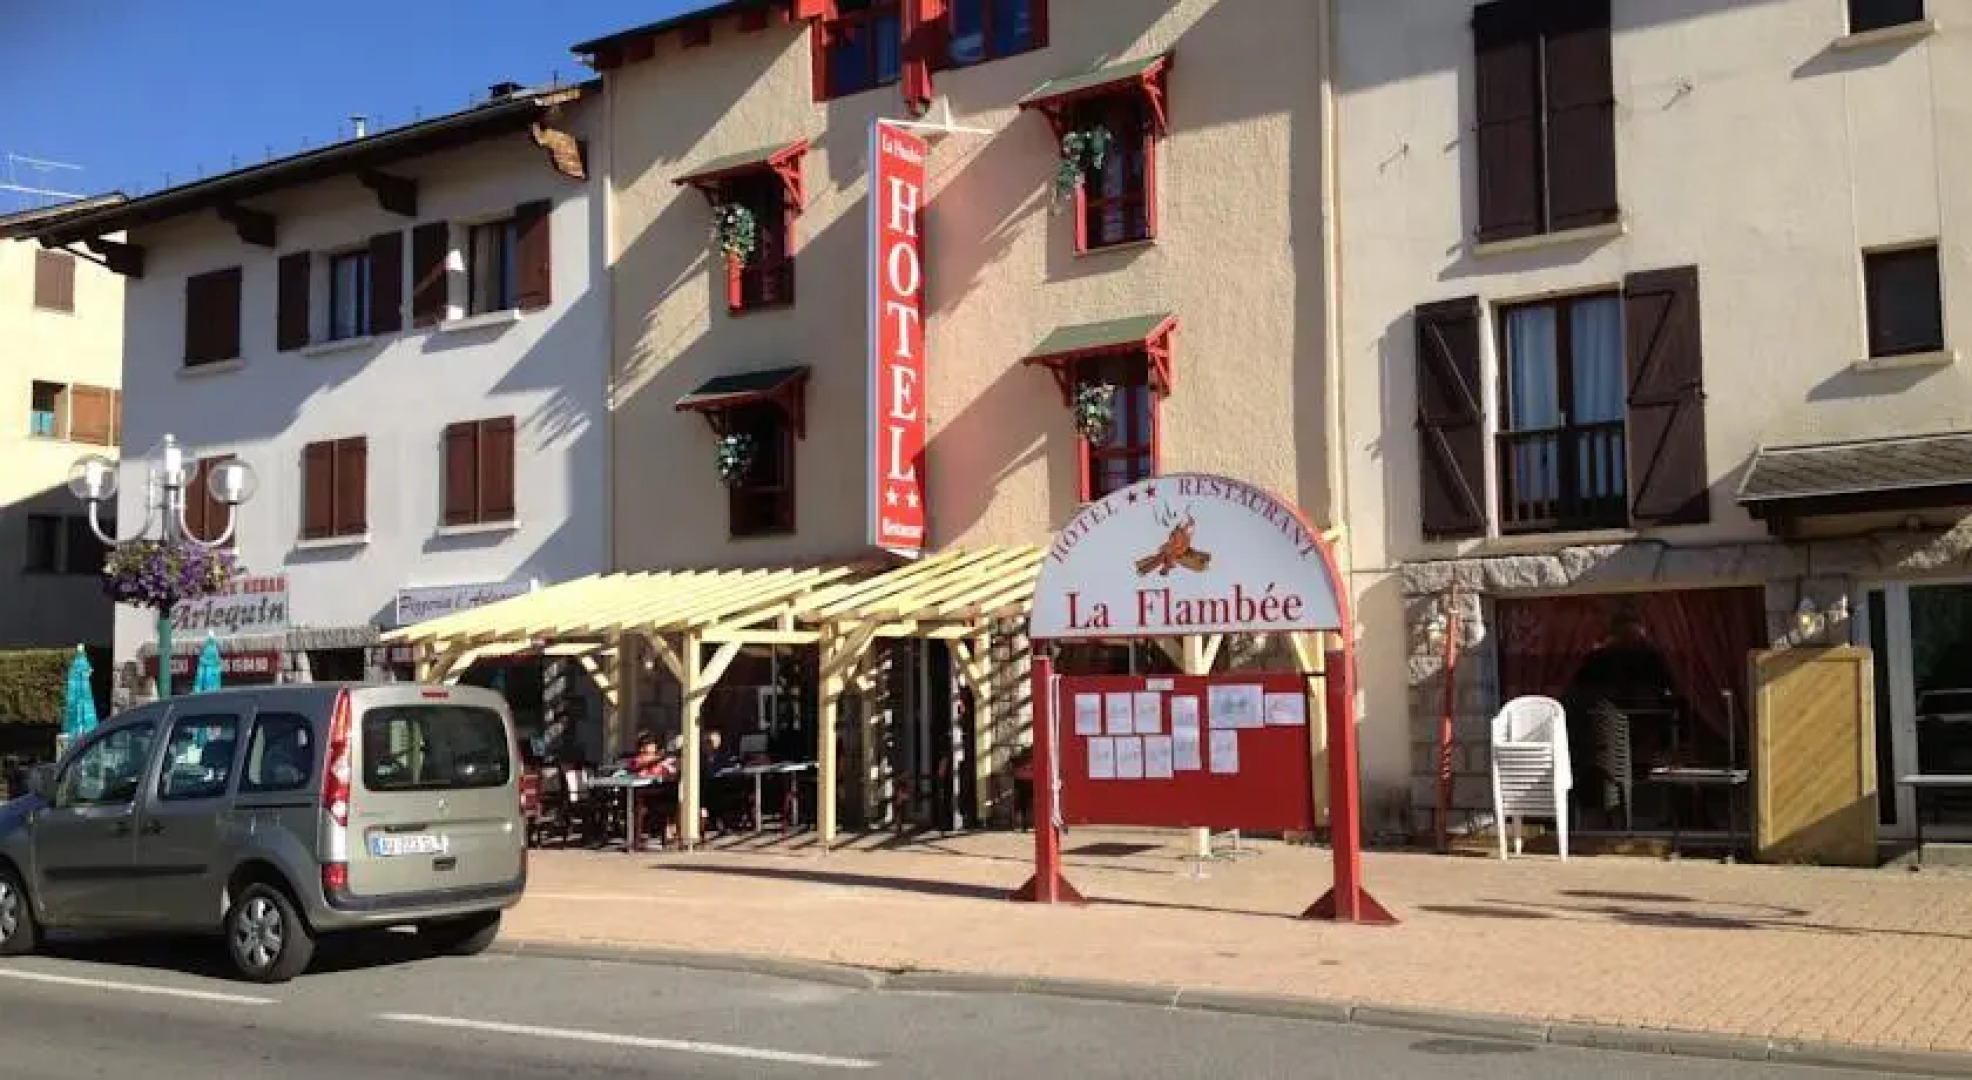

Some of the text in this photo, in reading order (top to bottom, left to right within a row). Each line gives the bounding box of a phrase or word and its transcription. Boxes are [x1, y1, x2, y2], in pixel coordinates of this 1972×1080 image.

[886, 175, 921, 482] HOTEL
[1050, 477, 1316, 564] HOTEL RESTAURANT
[171, 598, 284, 632] Arlequin
[1065, 582, 1303, 629] La Flambée
